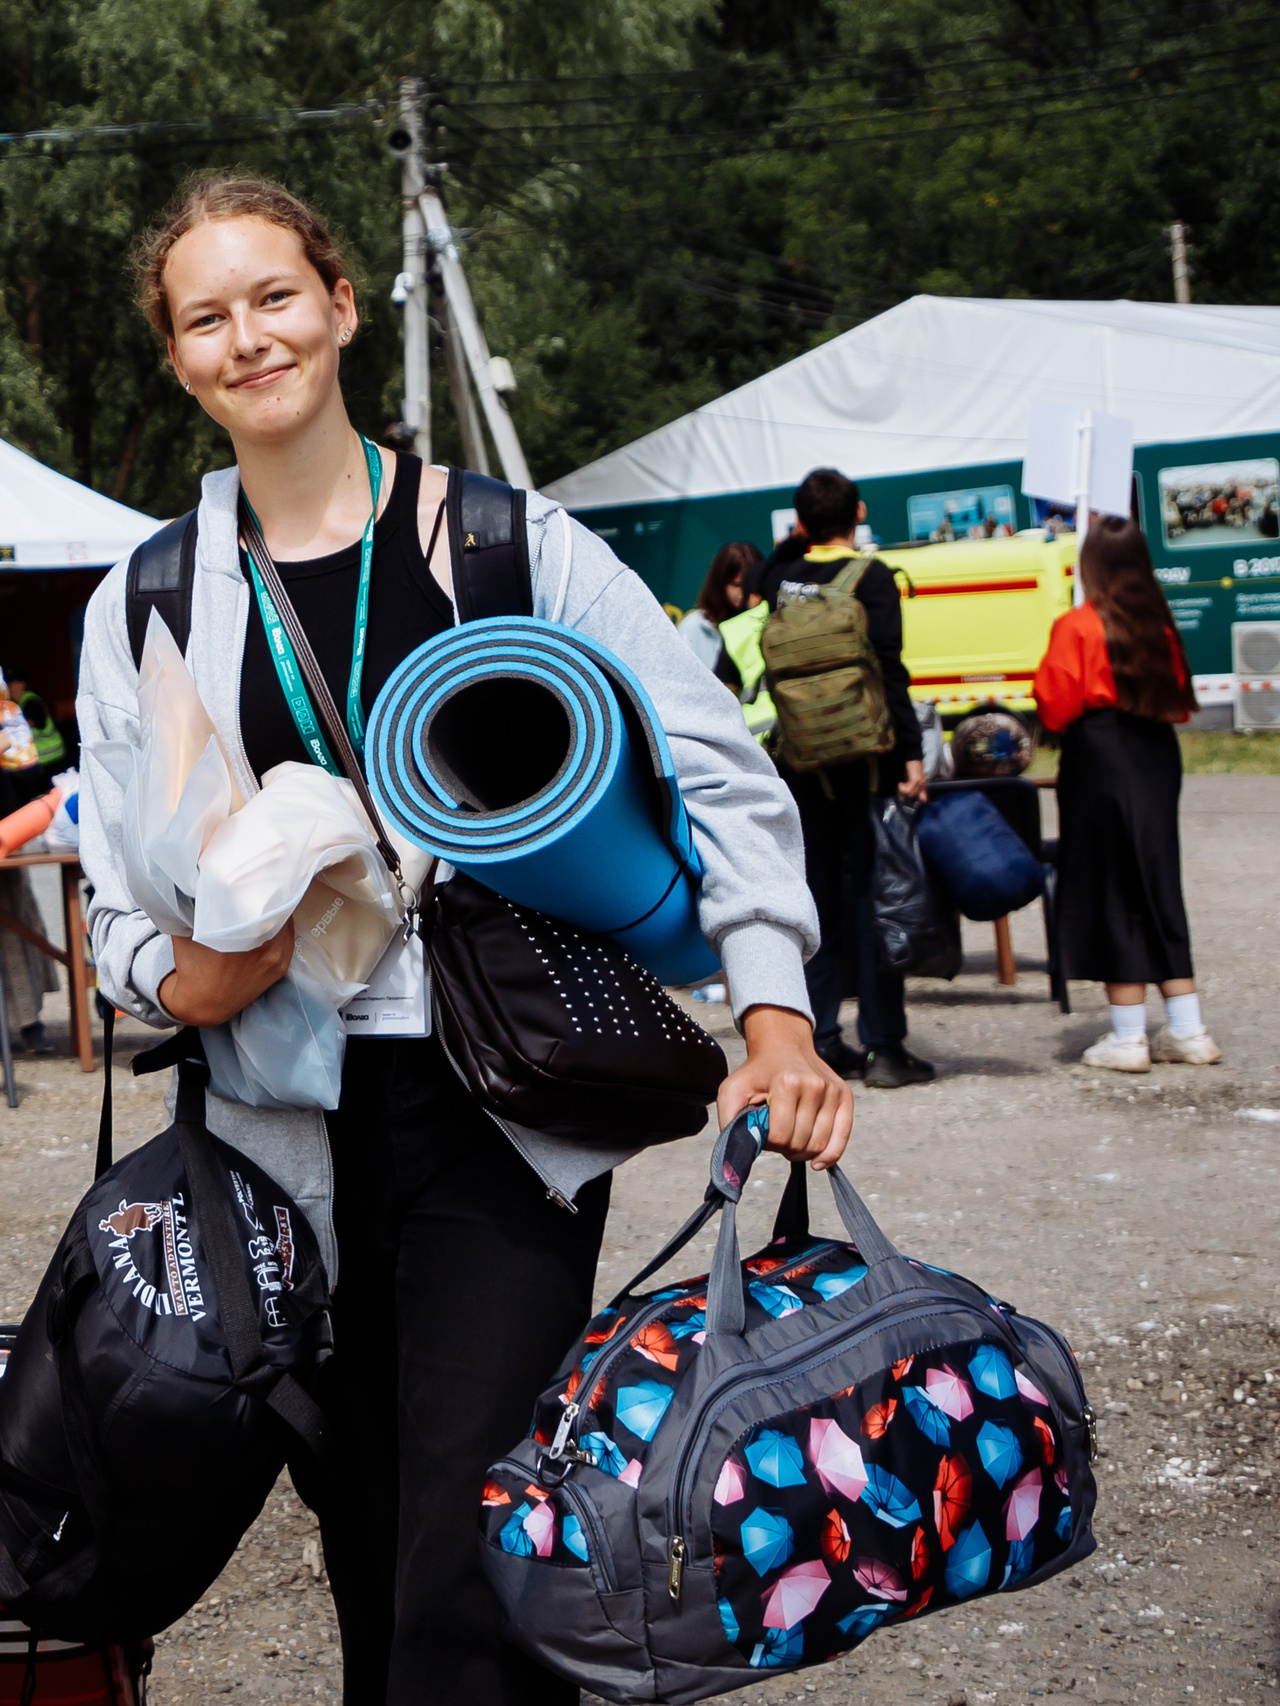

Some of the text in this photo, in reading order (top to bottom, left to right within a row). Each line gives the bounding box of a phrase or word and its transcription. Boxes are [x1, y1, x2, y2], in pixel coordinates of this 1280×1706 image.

[310, 897, 344, 938] ервые
[107, 1236, 172, 1315] INDIANA
[163, 1203, 185, 1312] WAY TO ADVENTURE
[174, 1210, 207, 1322] VERMONT
